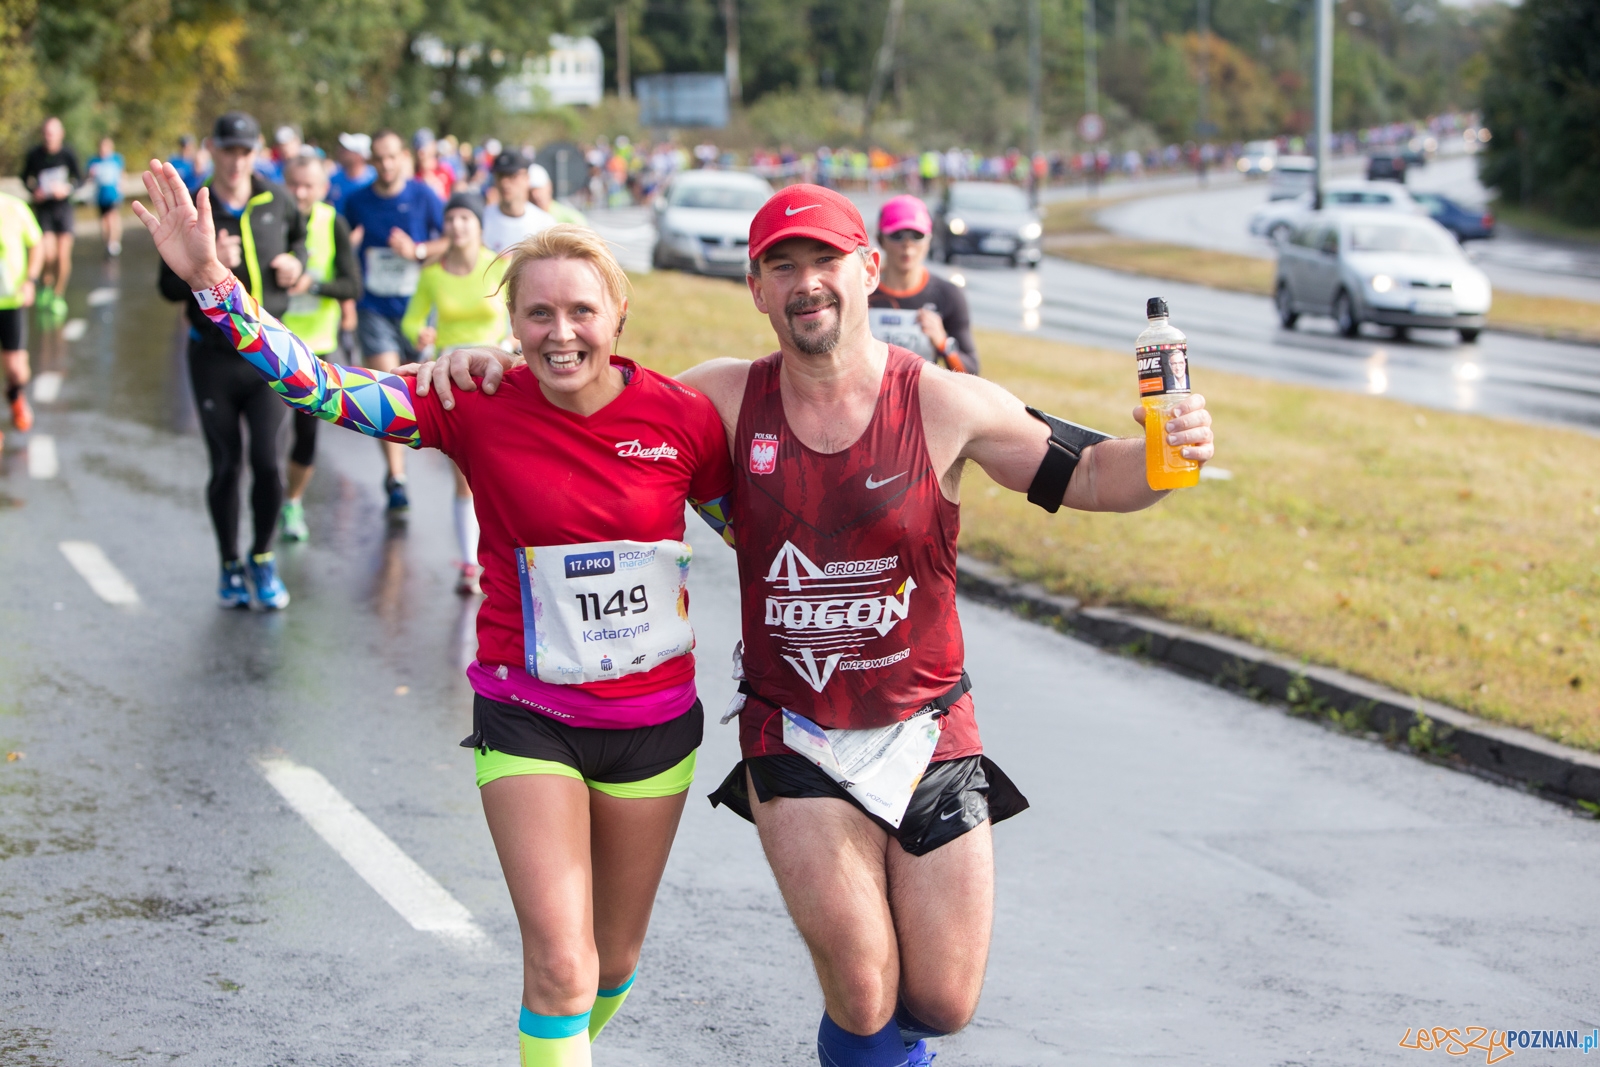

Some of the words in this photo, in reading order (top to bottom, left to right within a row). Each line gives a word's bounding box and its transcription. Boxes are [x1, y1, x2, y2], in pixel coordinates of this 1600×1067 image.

[754, 432, 778, 441] POLSKA
[615, 439, 678, 461] Danfoss
[586, 557, 611, 570] PKO
[619, 556, 655, 568] maraton
[824, 555, 899, 575] GRODZISK
[575, 584, 649, 622] 1149
[765, 576, 917, 637] DOGON
[583, 622, 650, 643] Katarzyna
[839, 648, 911, 671] MAZOWIECKI
[520, 698, 572, 719] DUNLOP
